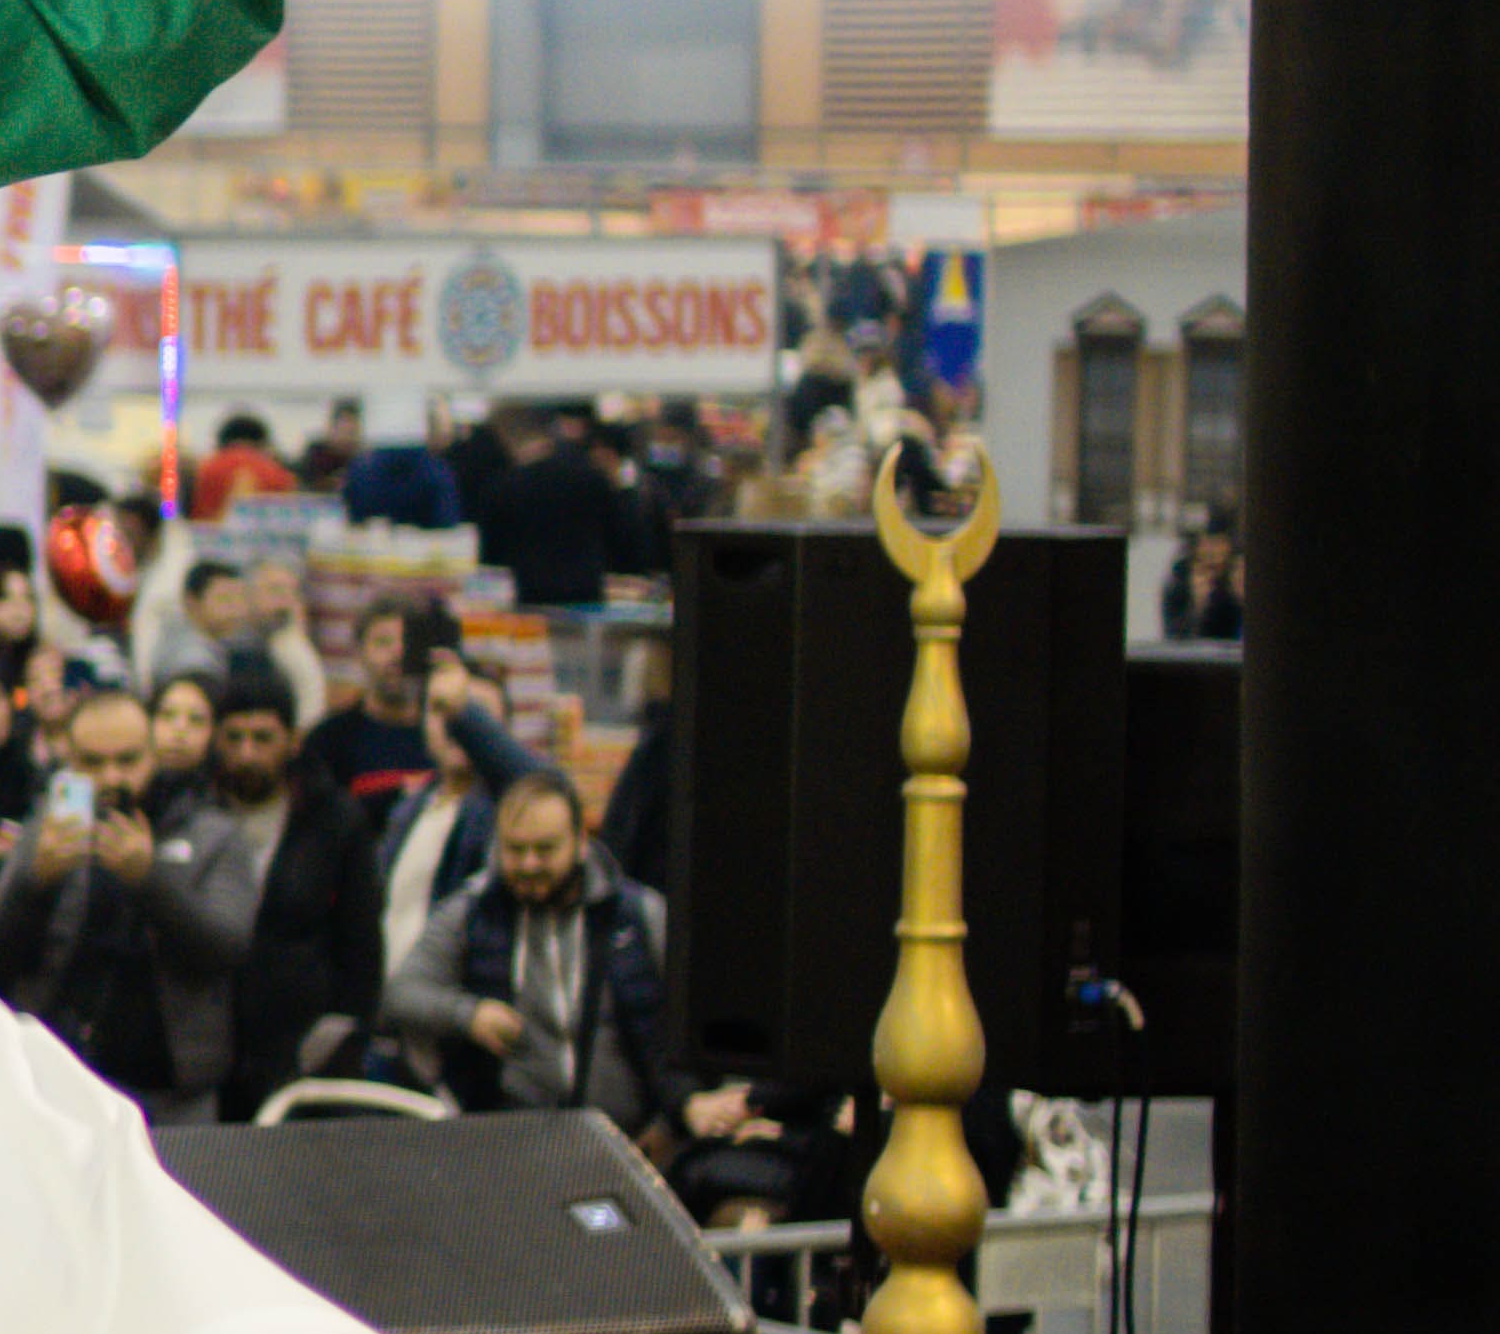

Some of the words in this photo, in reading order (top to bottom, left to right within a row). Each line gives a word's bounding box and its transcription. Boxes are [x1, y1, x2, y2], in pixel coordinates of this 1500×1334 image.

[186, 265, 279, 354] THÉ
[305, 265, 424, 354] CAFÉ
[530, 280, 768, 351] BOISSONS
